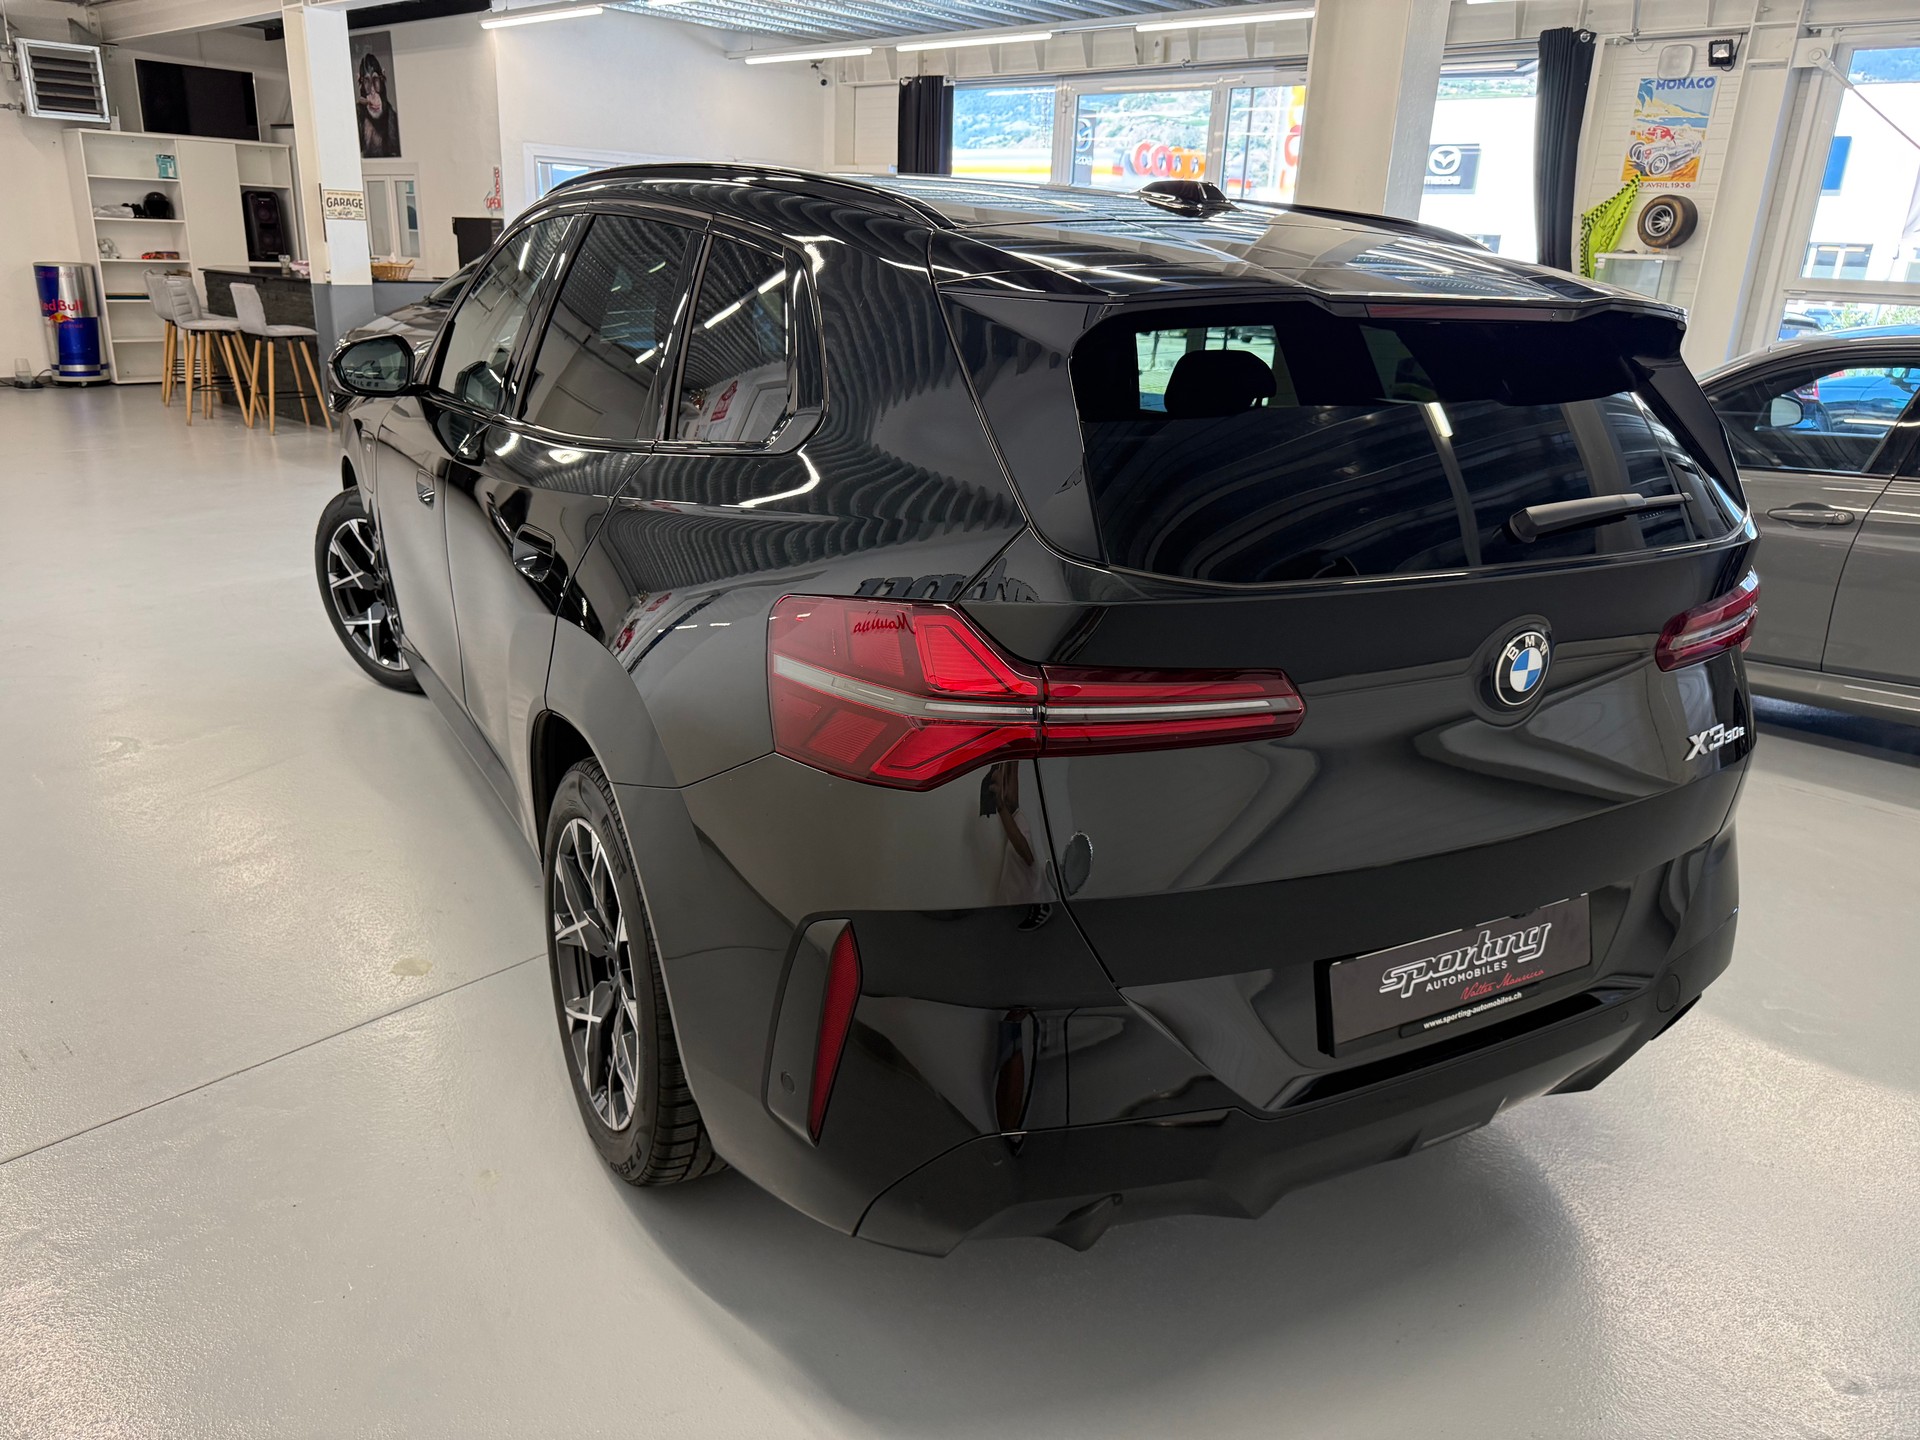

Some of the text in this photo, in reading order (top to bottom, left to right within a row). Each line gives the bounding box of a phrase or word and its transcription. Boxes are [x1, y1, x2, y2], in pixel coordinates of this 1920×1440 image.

[1655, 77, 1715, 90] MONACO
[326, 197, 364, 210] GARAGE
[58, 299, 84, 312] Bull
[1506, 634, 1549, 662] BMW
[1684, 723, 1725, 762] X3
[1379, 922, 1553, 999] sporting
[1425, 959, 1509, 993] AUTOMOBILES
[1422, 991, 1523, 1030] www.sporting-automobiles.ch
